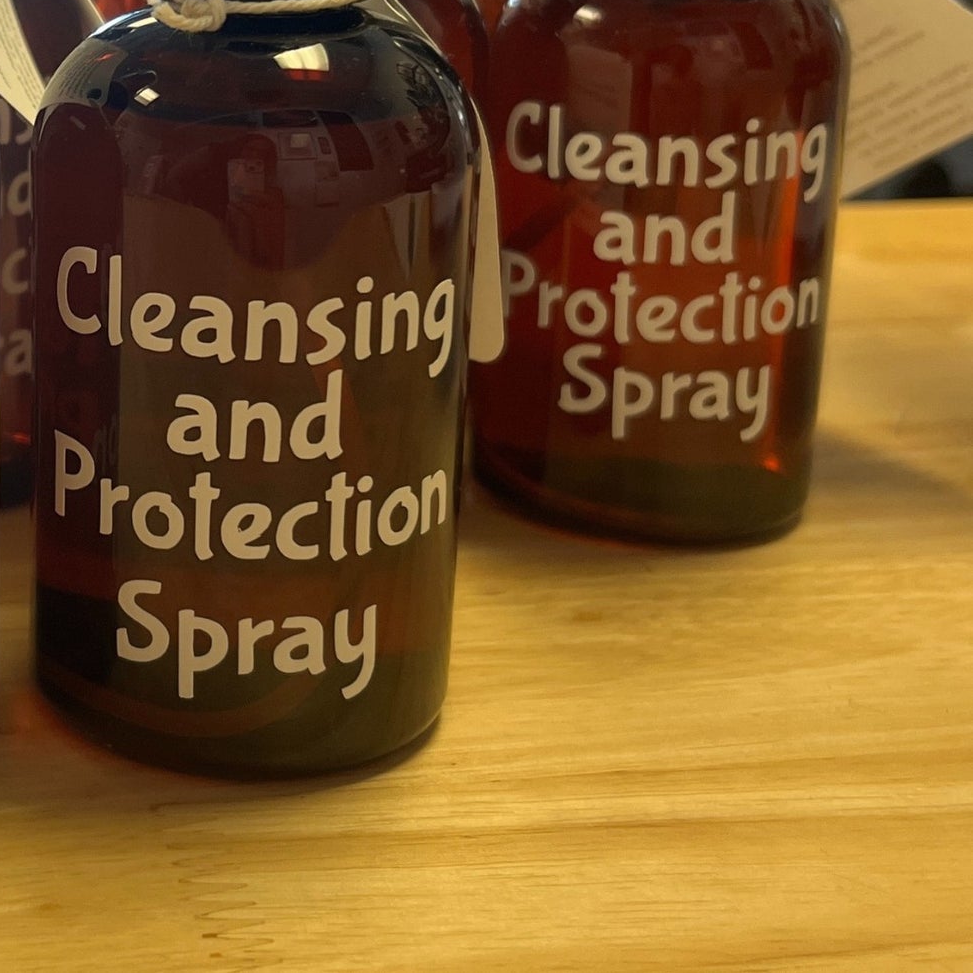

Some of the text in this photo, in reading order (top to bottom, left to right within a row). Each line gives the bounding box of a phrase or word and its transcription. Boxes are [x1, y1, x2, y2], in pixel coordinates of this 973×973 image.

[506, 101, 827, 203] Cleansing
[593, 190, 737, 266] and
[56, 246, 455, 377] Cleansing
[500, 249, 820, 345] Protection
[166, 371, 344, 462] and
[557, 343, 771, 443] Spray
[53, 429, 447, 562] Protection
[116, 579, 378, 700] Spray
